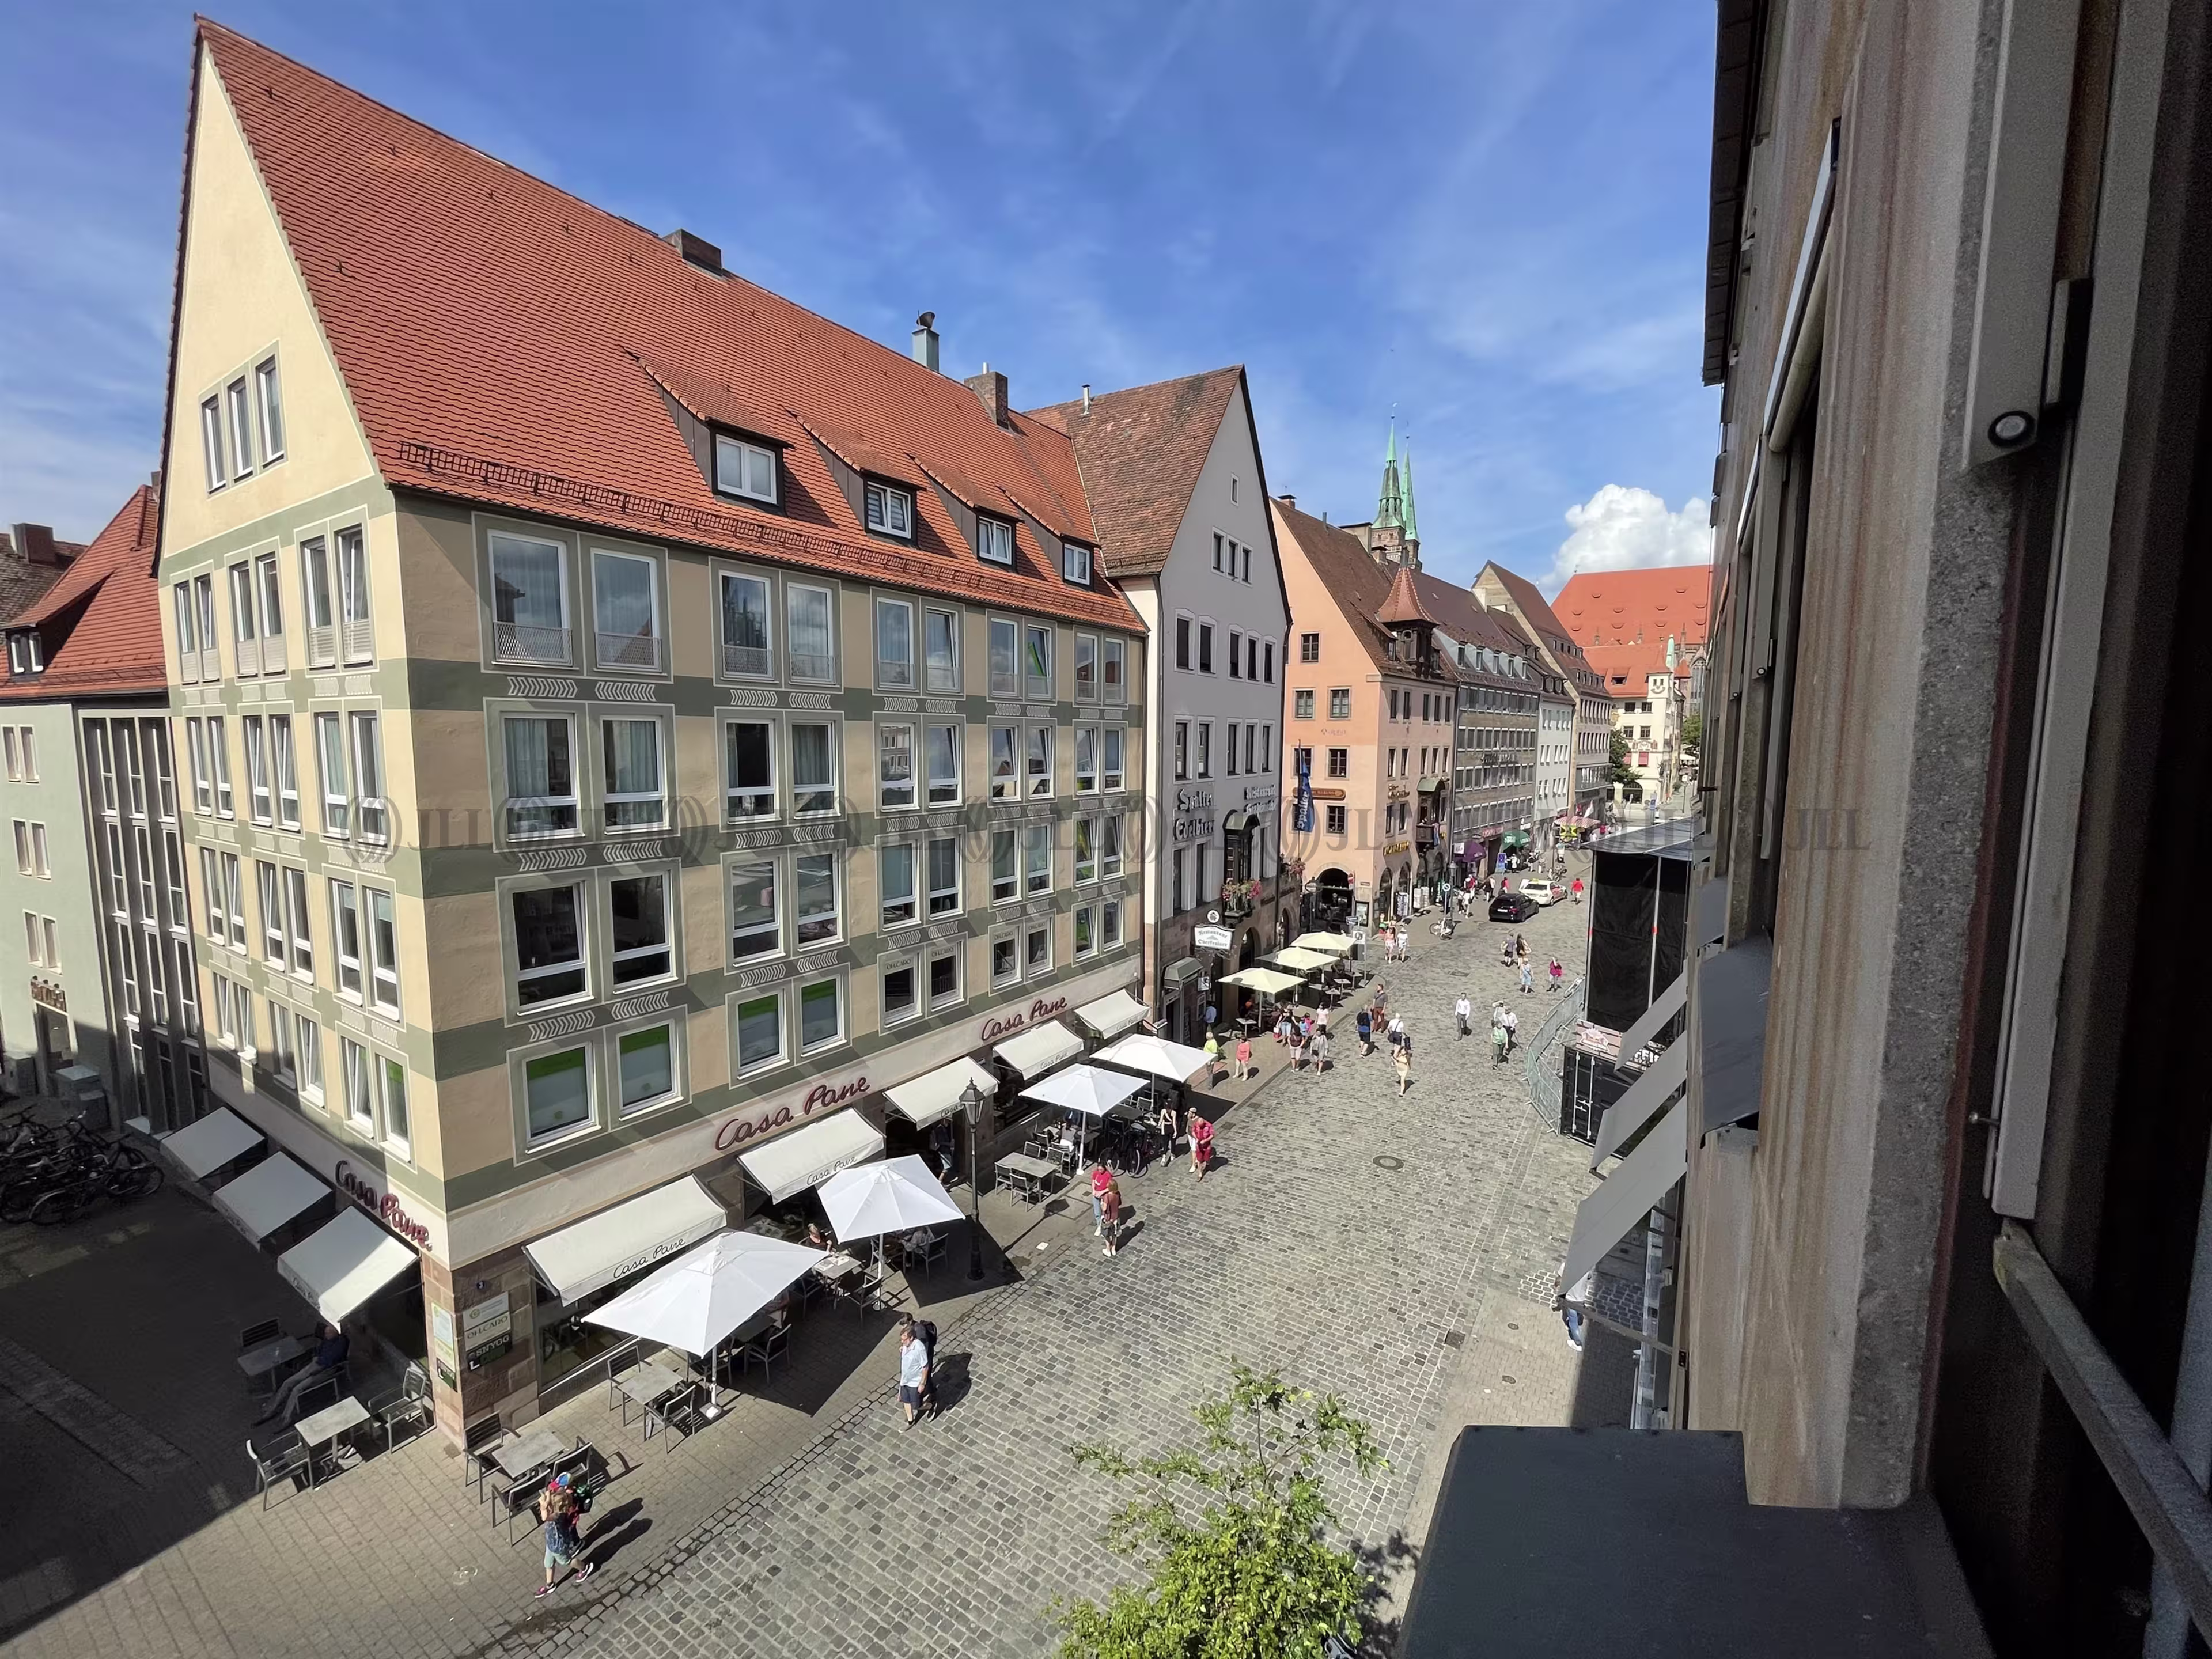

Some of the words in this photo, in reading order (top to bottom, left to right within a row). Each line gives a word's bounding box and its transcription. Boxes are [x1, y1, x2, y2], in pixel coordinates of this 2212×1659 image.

[982, 1013, 1024, 1041] Casa
[1030, 997, 1067, 1021] Pane
[715, 1107, 794, 1151] Casa
[804, 1077, 871, 1115] Pane
[806, 1170, 830, 1185] Casa
[834, 1156, 857, 1172] Pane
[336, 1160, 377, 1210] Casa
[380, 1193, 433, 1252] Pane
[613, 1256, 648, 1278] Casa
[653, 1237, 686, 1259] Pane
